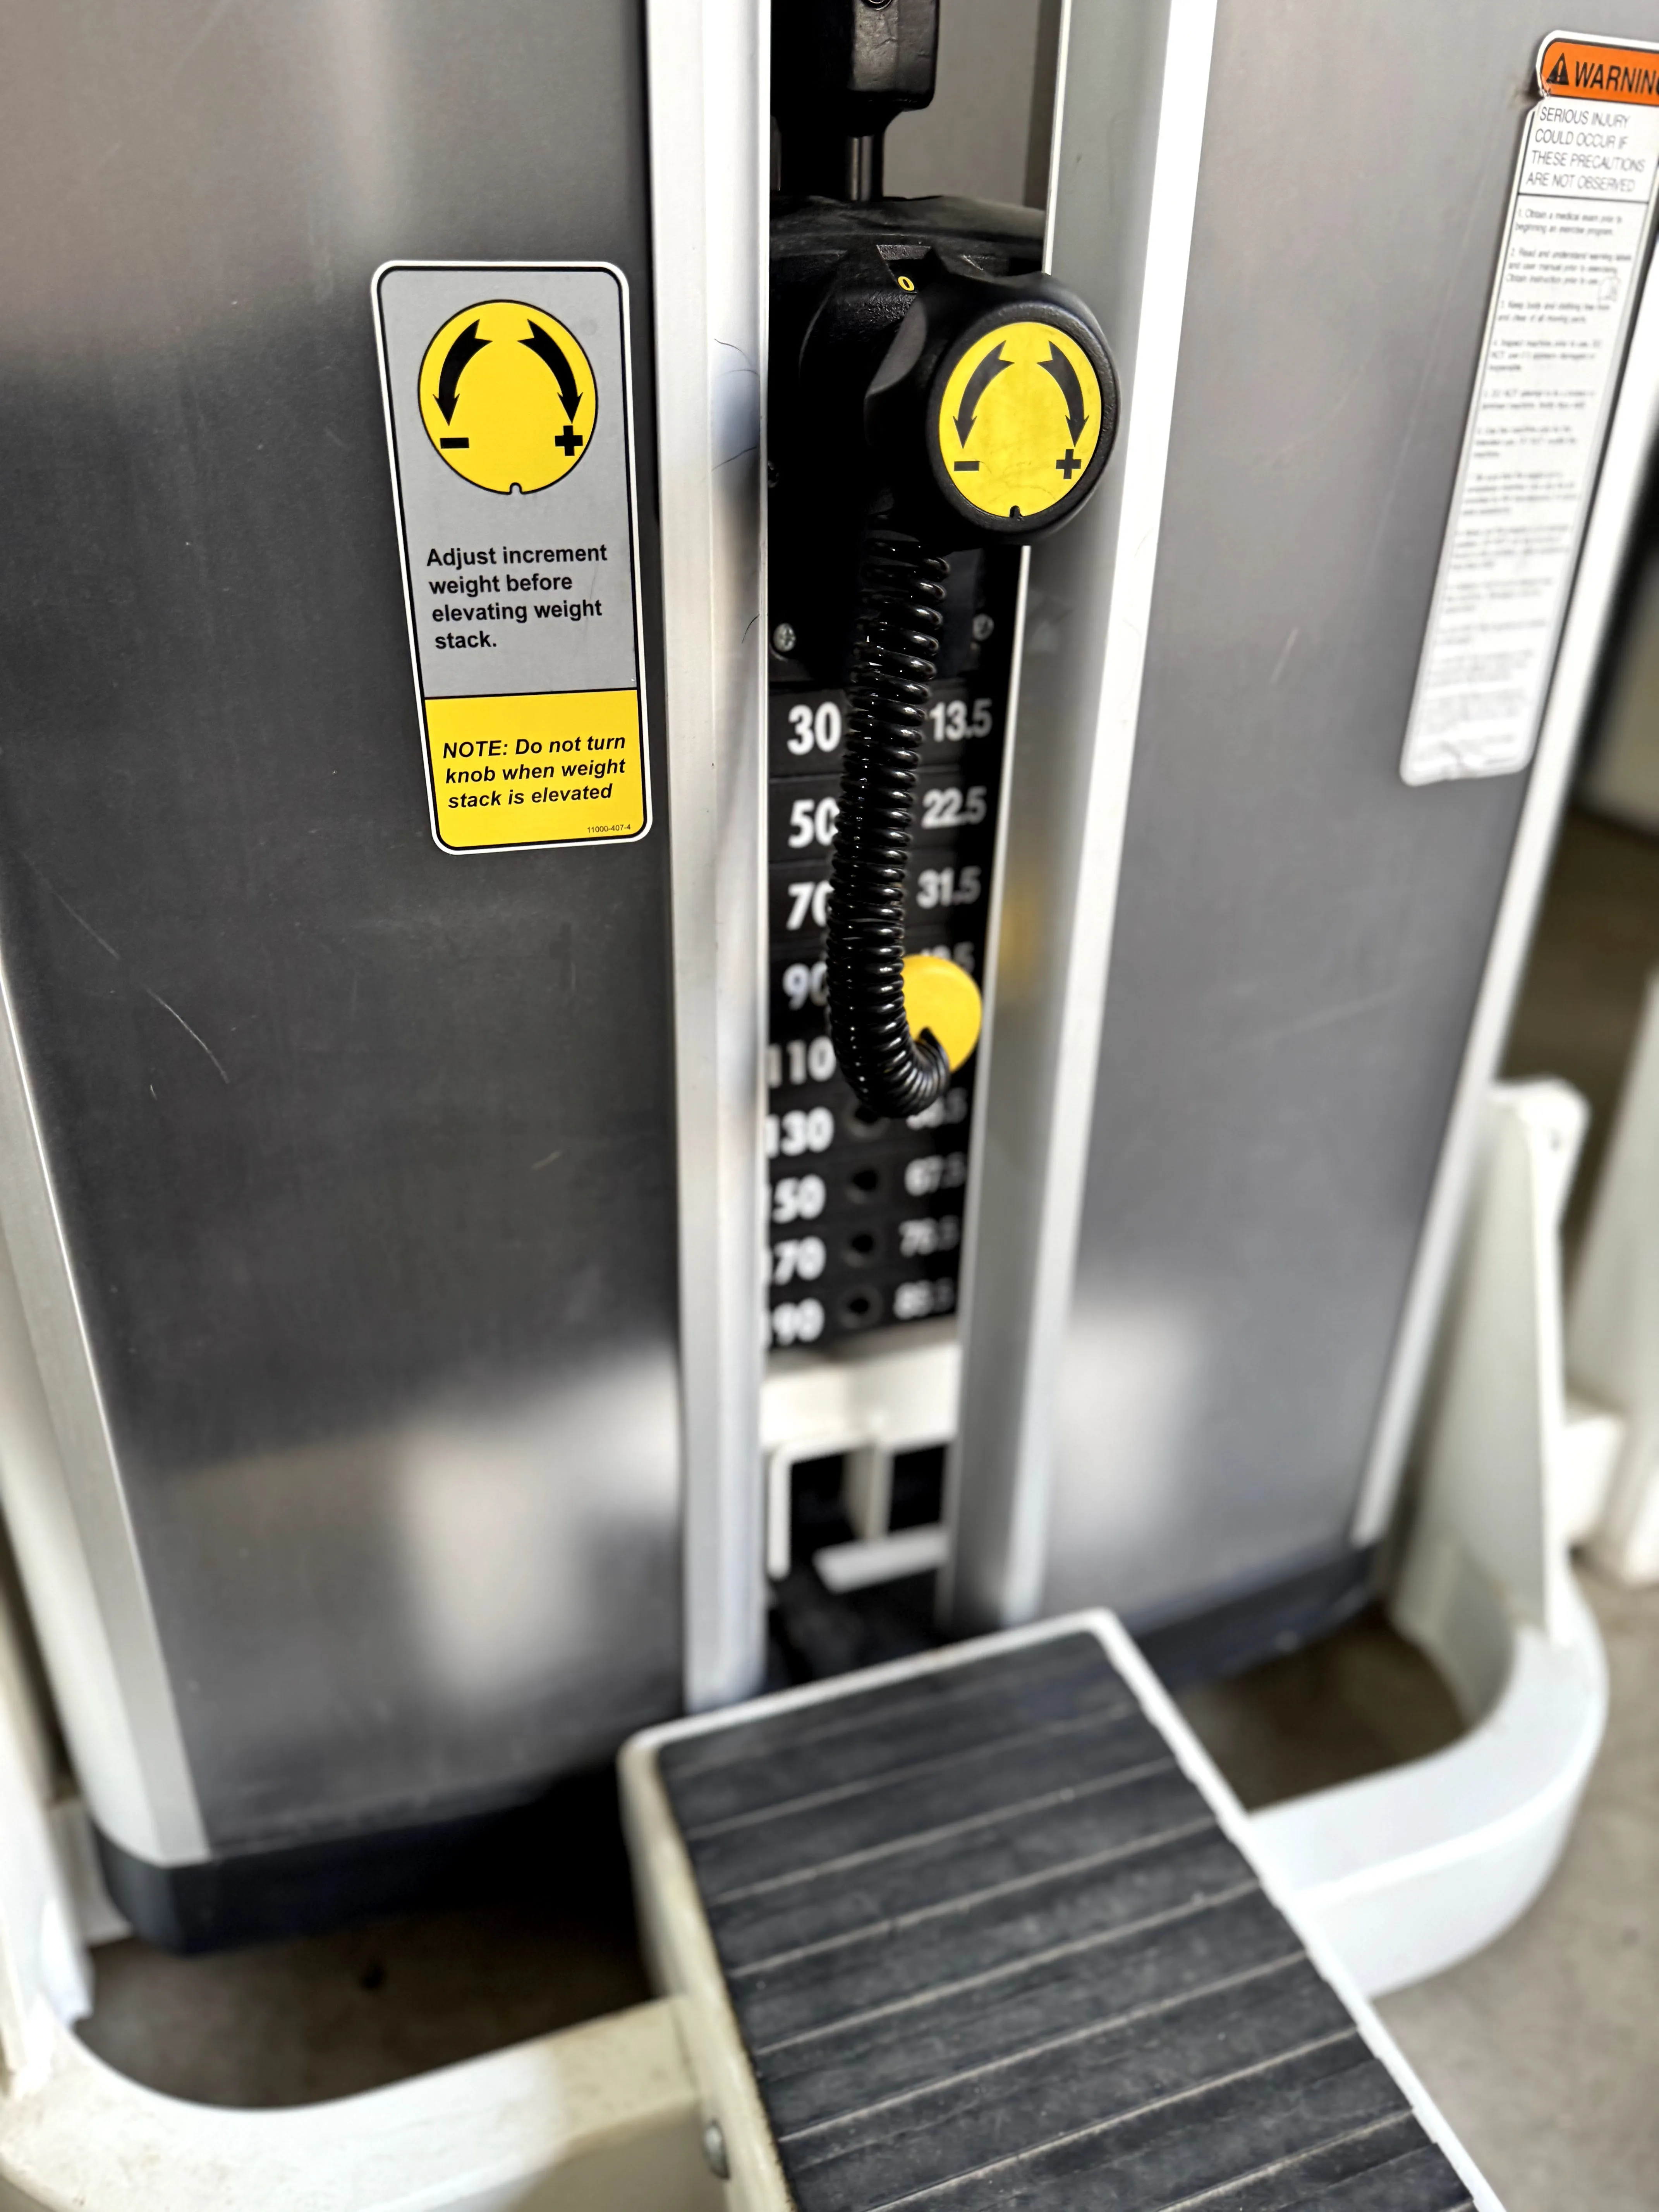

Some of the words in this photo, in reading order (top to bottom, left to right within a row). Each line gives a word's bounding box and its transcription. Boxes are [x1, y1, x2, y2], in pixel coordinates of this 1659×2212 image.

[1575, 60, 1659, 96] WARNIN
[1540, 106, 1589, 125] SERIOUS
[1591, 112, 1631, 129] INJURY
[1535, 128, 1574, 145] COULD
[1576, 132, 1616, 149] OCCUR
[1618, 136, 1629, 149] IF
[1532, 150, 1568, 167] THESE
[1570, 153, 1646, 173] PRECAUTIONS
[1525, 172, 1550, 186] ARE
[1552, 174, 1576, 188] NOT
[1577, 175, 1635, 192] OBSERVED
[426, 547, 497, 570] Adjust
[503, 544, 608, 565] increment
[428, 574, 501, 598] weight
[506, 573, 573, 592] before
[432, 602, 527, 624] elevating
[534, 599, 603, 622] weight
[435, 630, 497, 649] stack.
[787, 701, 842, 756] 30
[930, 698, 993, 742] 13.5
[443, 740, 508, 759] NOTE:
[515, 738, 543, 755] Do
[549, 736, 582, 753] not
[587, 735, 626, 751] turn
[446, 766, 496, 784] knob
[502, 764, 555, 780] when
[562, 758, 626, 779] weight
[448, 790, 502, 809] stack
[508, 789, 524, 805] is
[531, 783, 613, 803] elevated
[921, 786, 988, 830] 22.5
[587, 824, 631, 833] 11000-407-4
[787, 797, 840, 848] 50
[916, 865, 982, 909] 31.5
[769, 1174, 826, 1224] 50
[769, 1235, 826, 1285] 70
